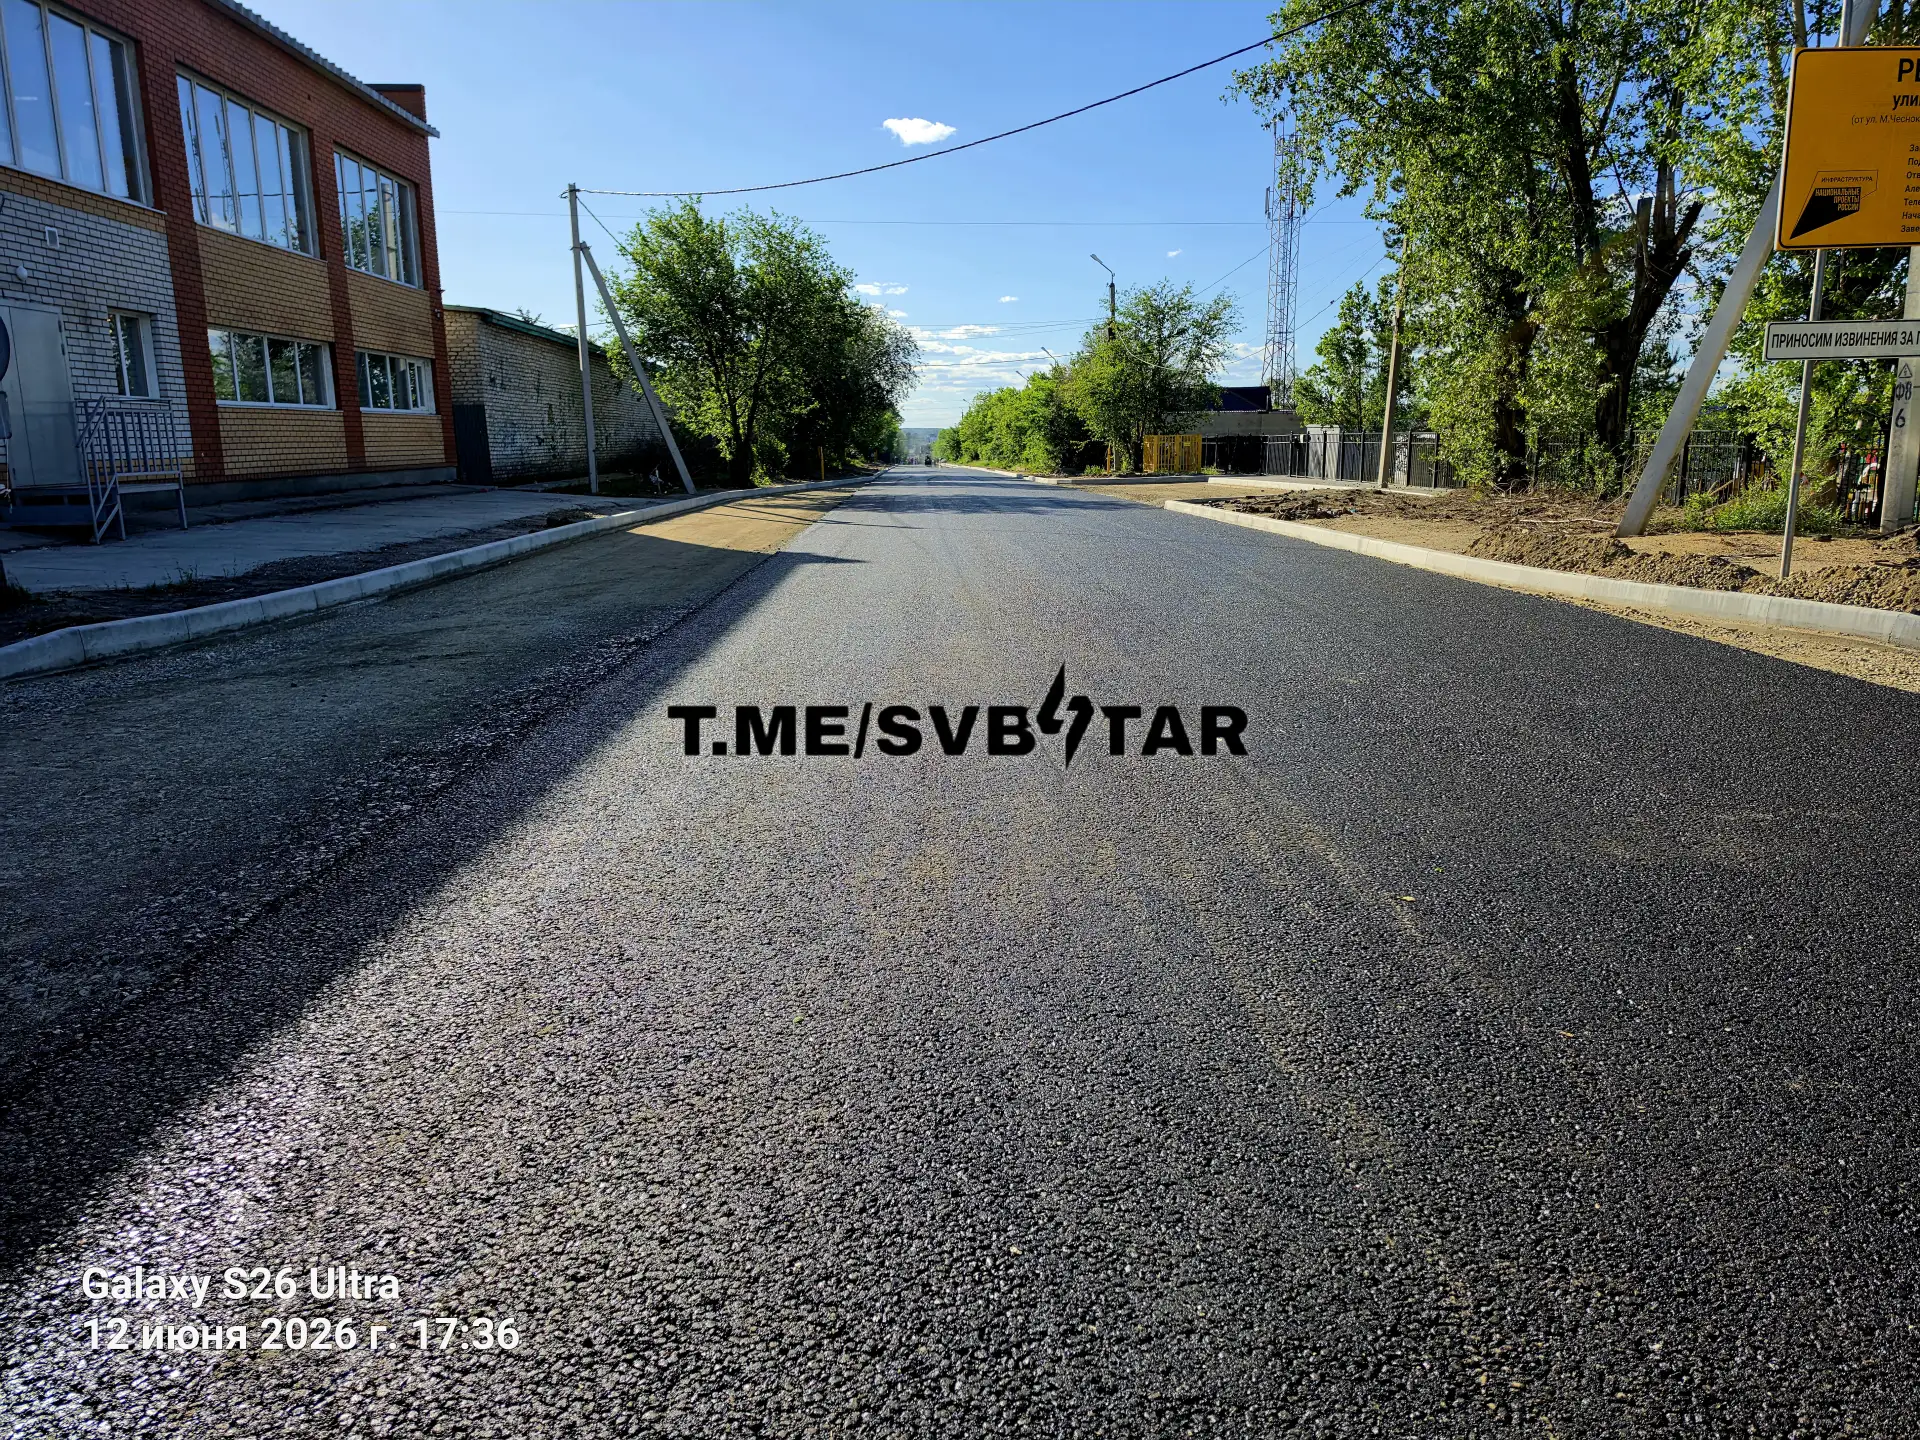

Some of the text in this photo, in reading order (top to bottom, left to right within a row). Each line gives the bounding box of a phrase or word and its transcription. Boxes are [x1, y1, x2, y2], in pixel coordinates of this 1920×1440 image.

[1892, 94, 1920, 111] ули
[1821, 175, 1873, 183] ИНФРАСТРУКТУРА
[1815, 187, 1860, 197] НАЦИОНАЛЬНЫЕ
[1833, 195, 1860, 204] ПРОЕКТЫ
[1837, 203, 1859, 211] РОССИИ
[1771, 332, 1833, 348] ПРИНОСИМ
[1834, 331, 1898, 347] ИЗВИНЕНИЯ
[1900, 330, 1914, 345] ЗА
[1895, 408, 1906, 428] 6
